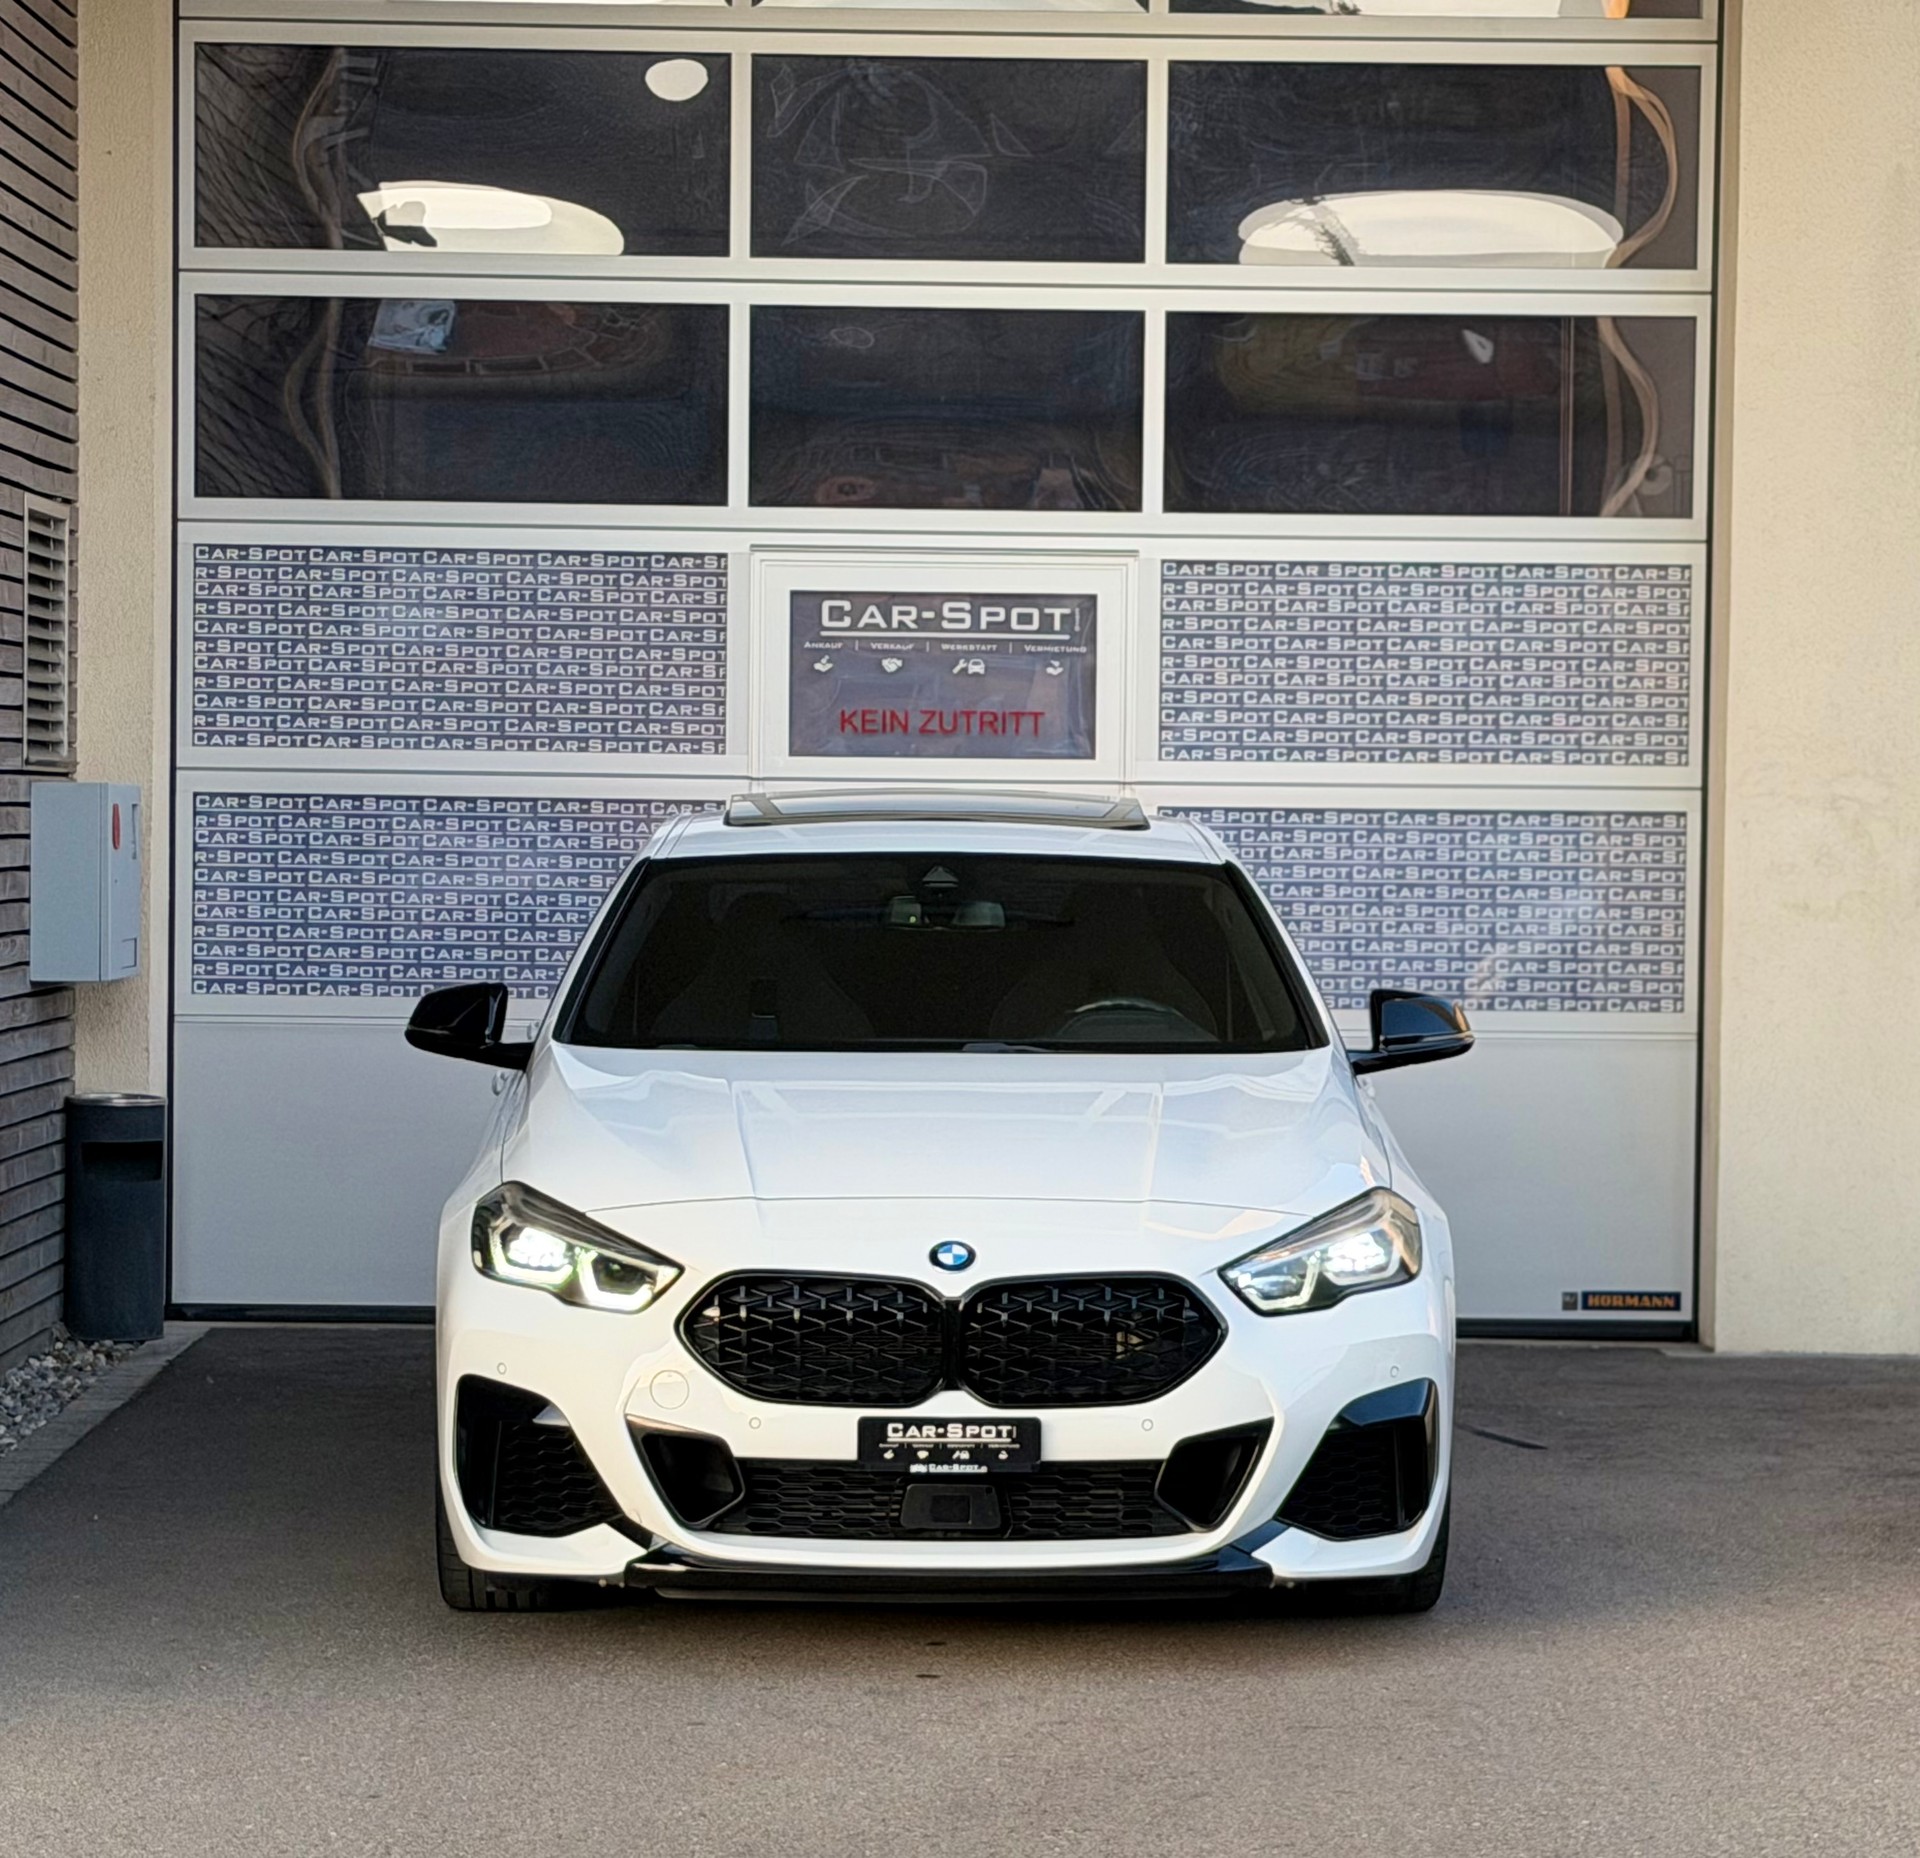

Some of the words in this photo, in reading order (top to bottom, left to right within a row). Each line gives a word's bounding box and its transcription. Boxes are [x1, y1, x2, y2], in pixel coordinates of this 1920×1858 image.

[821, 600, 1071, 632] CAR-SPOT
[839, 709, 909, 735] KEIN
[918, 709, 1046, 737] ZUTRITT
[887, 1423, 1012, 1438] CAR-SPOT
